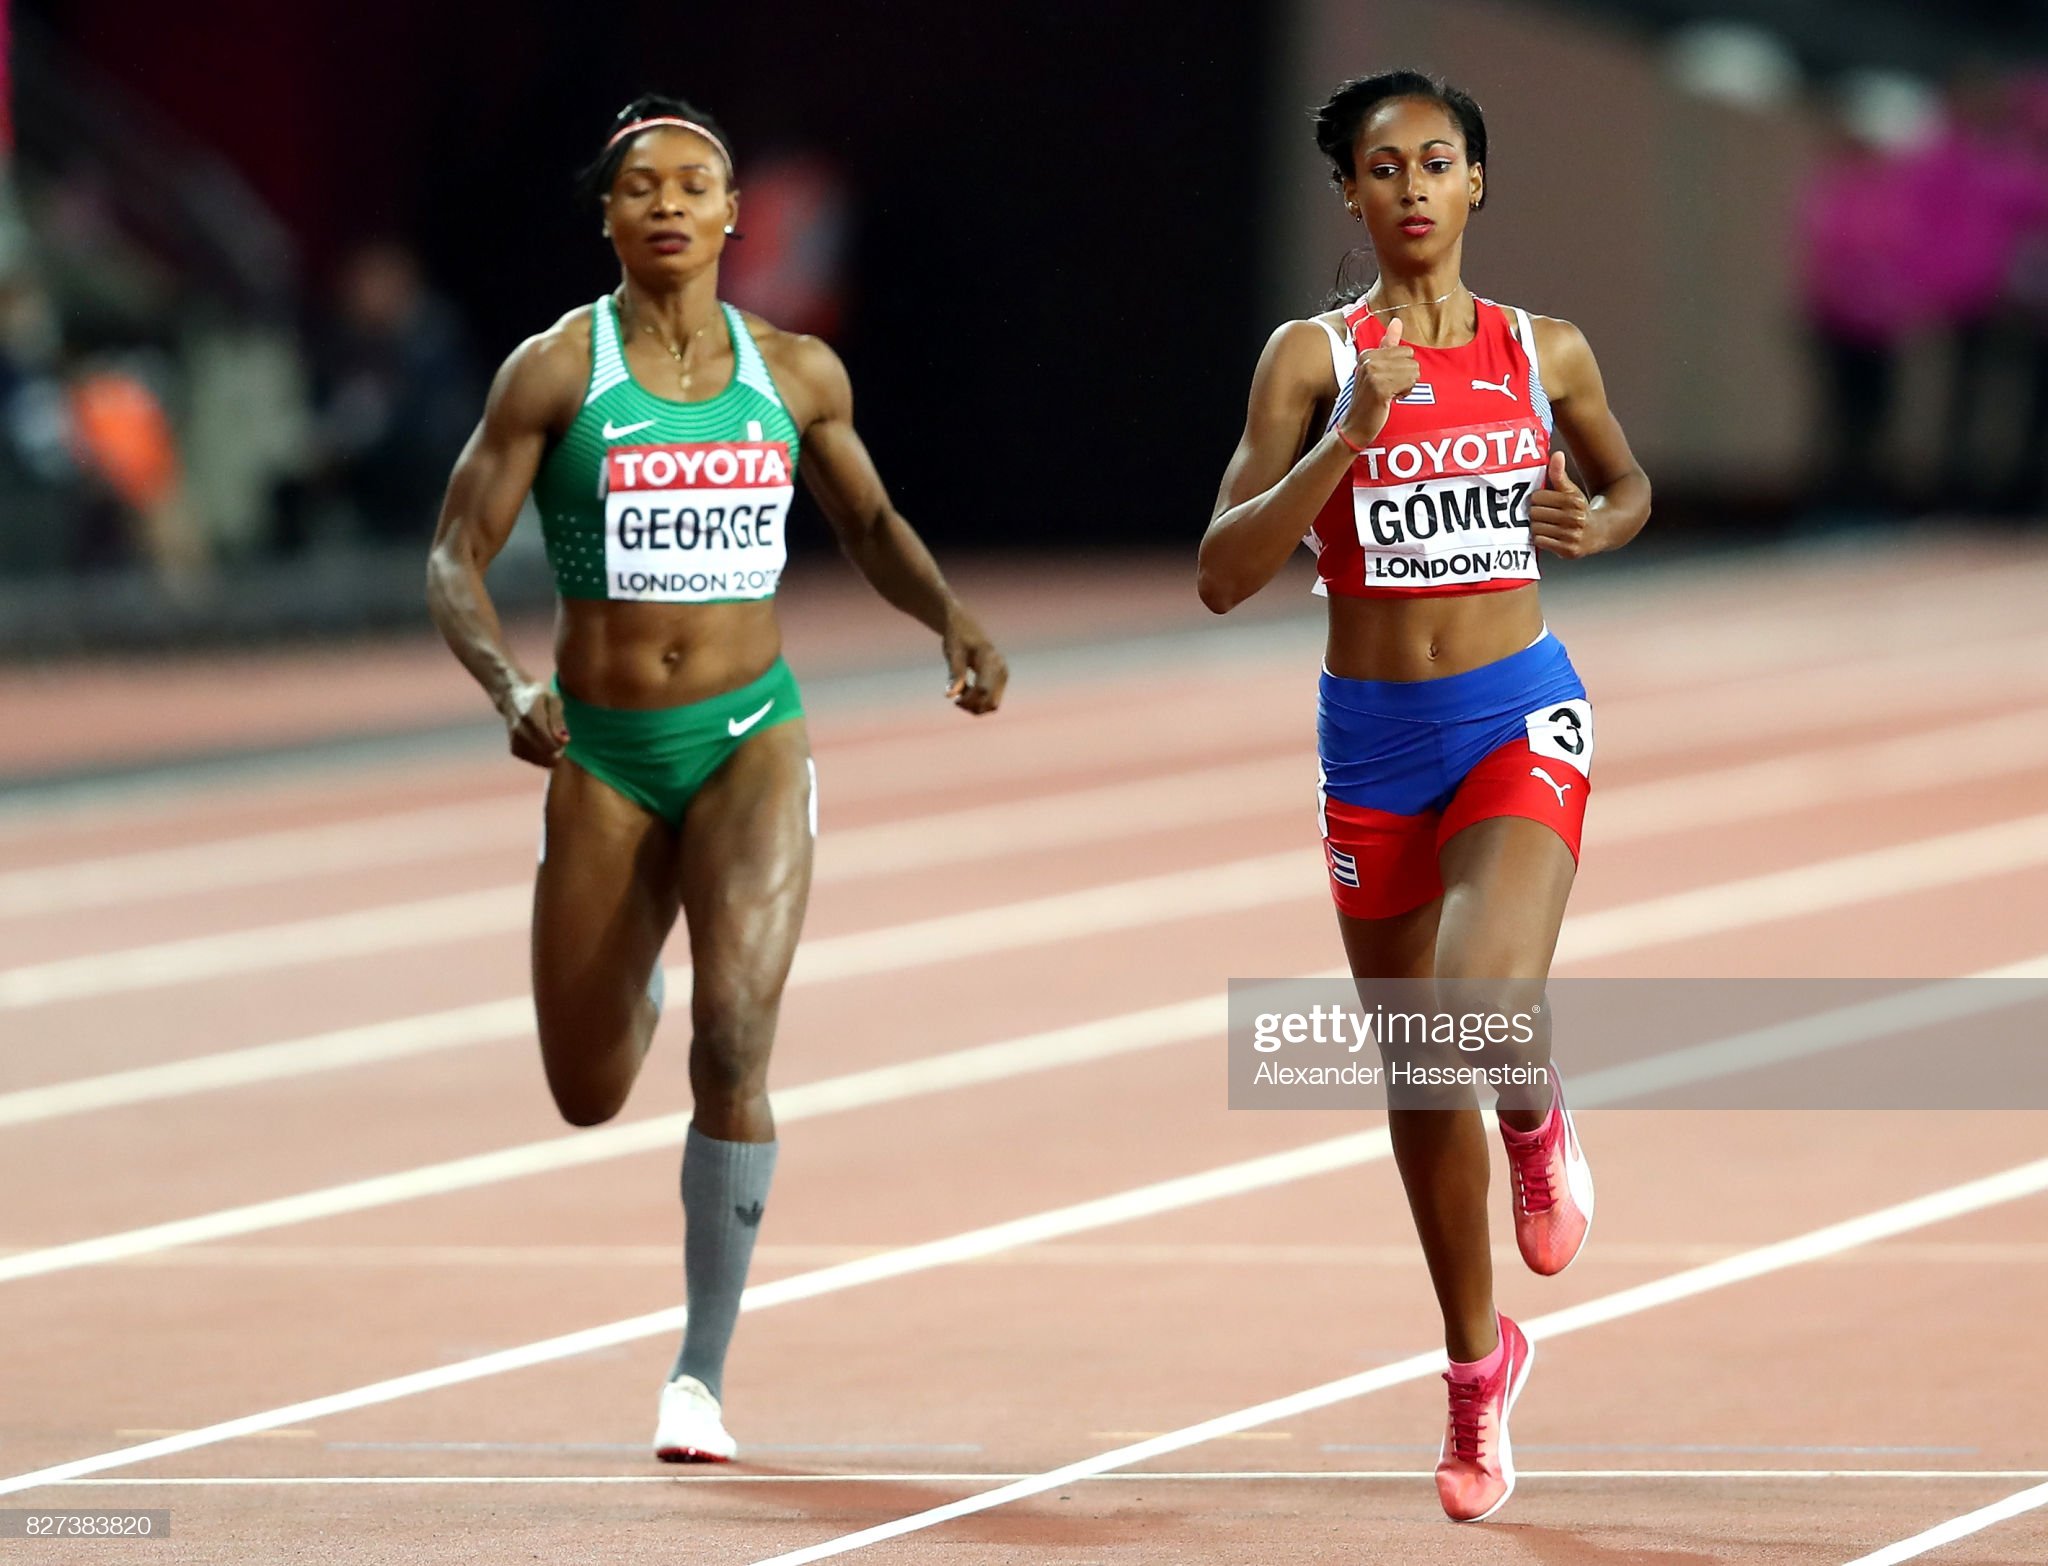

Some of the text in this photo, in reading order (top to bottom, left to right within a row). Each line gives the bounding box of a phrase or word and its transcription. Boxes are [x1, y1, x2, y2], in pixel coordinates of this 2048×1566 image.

[615, 449, 788, 487] TOYOTA
[1359, 427, 1542, 480] TOYOTA
[618, 504, 779, 550] GEORGE
[1369, 481, 1532, 546] GÓMEZ
[617, 568, 781, 592] LONDON 20
[1375, 552, 1491, 579] LONDON
[1549, 707, 1585, 755] 3
